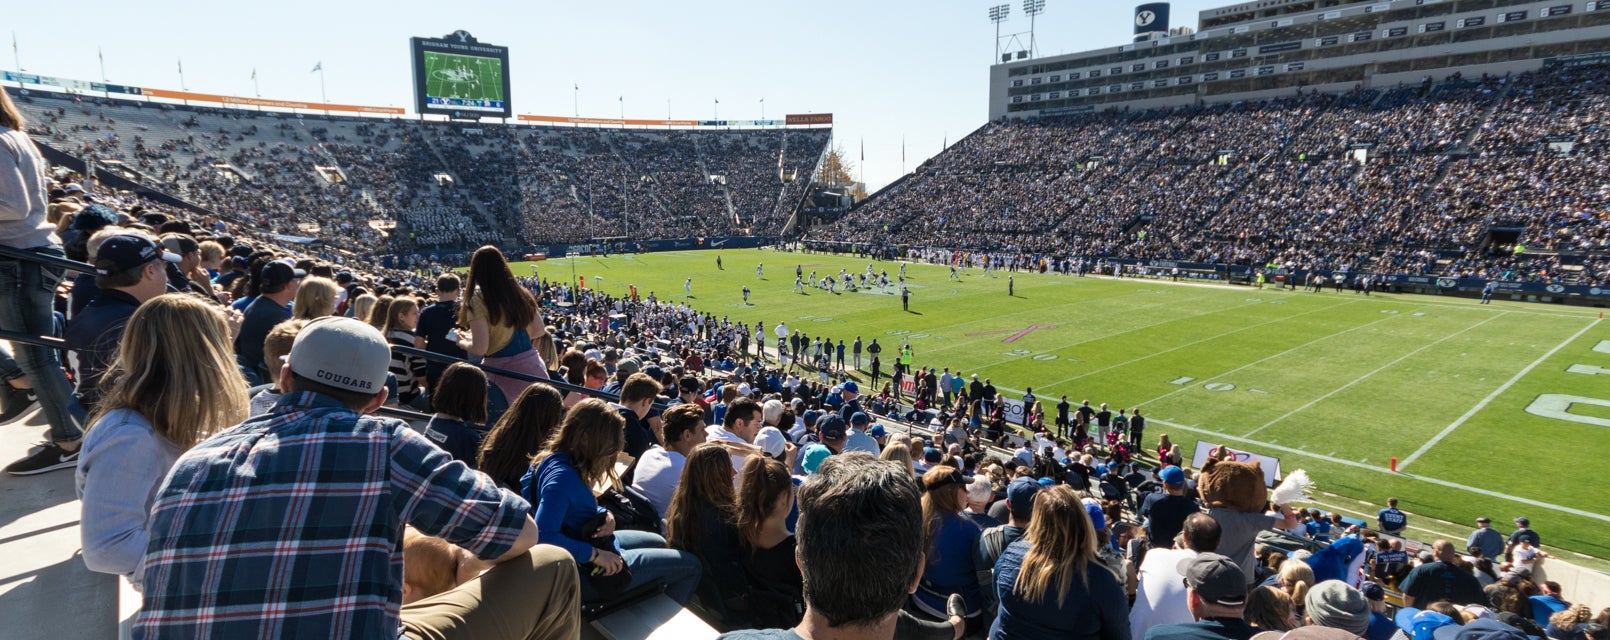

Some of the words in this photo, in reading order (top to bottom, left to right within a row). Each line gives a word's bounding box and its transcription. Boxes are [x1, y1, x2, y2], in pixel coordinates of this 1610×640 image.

[1138, 12, 1152, 25] Y
[457, 31, 469, 42] Y
[317, 370, 372, 389] COUGARS
